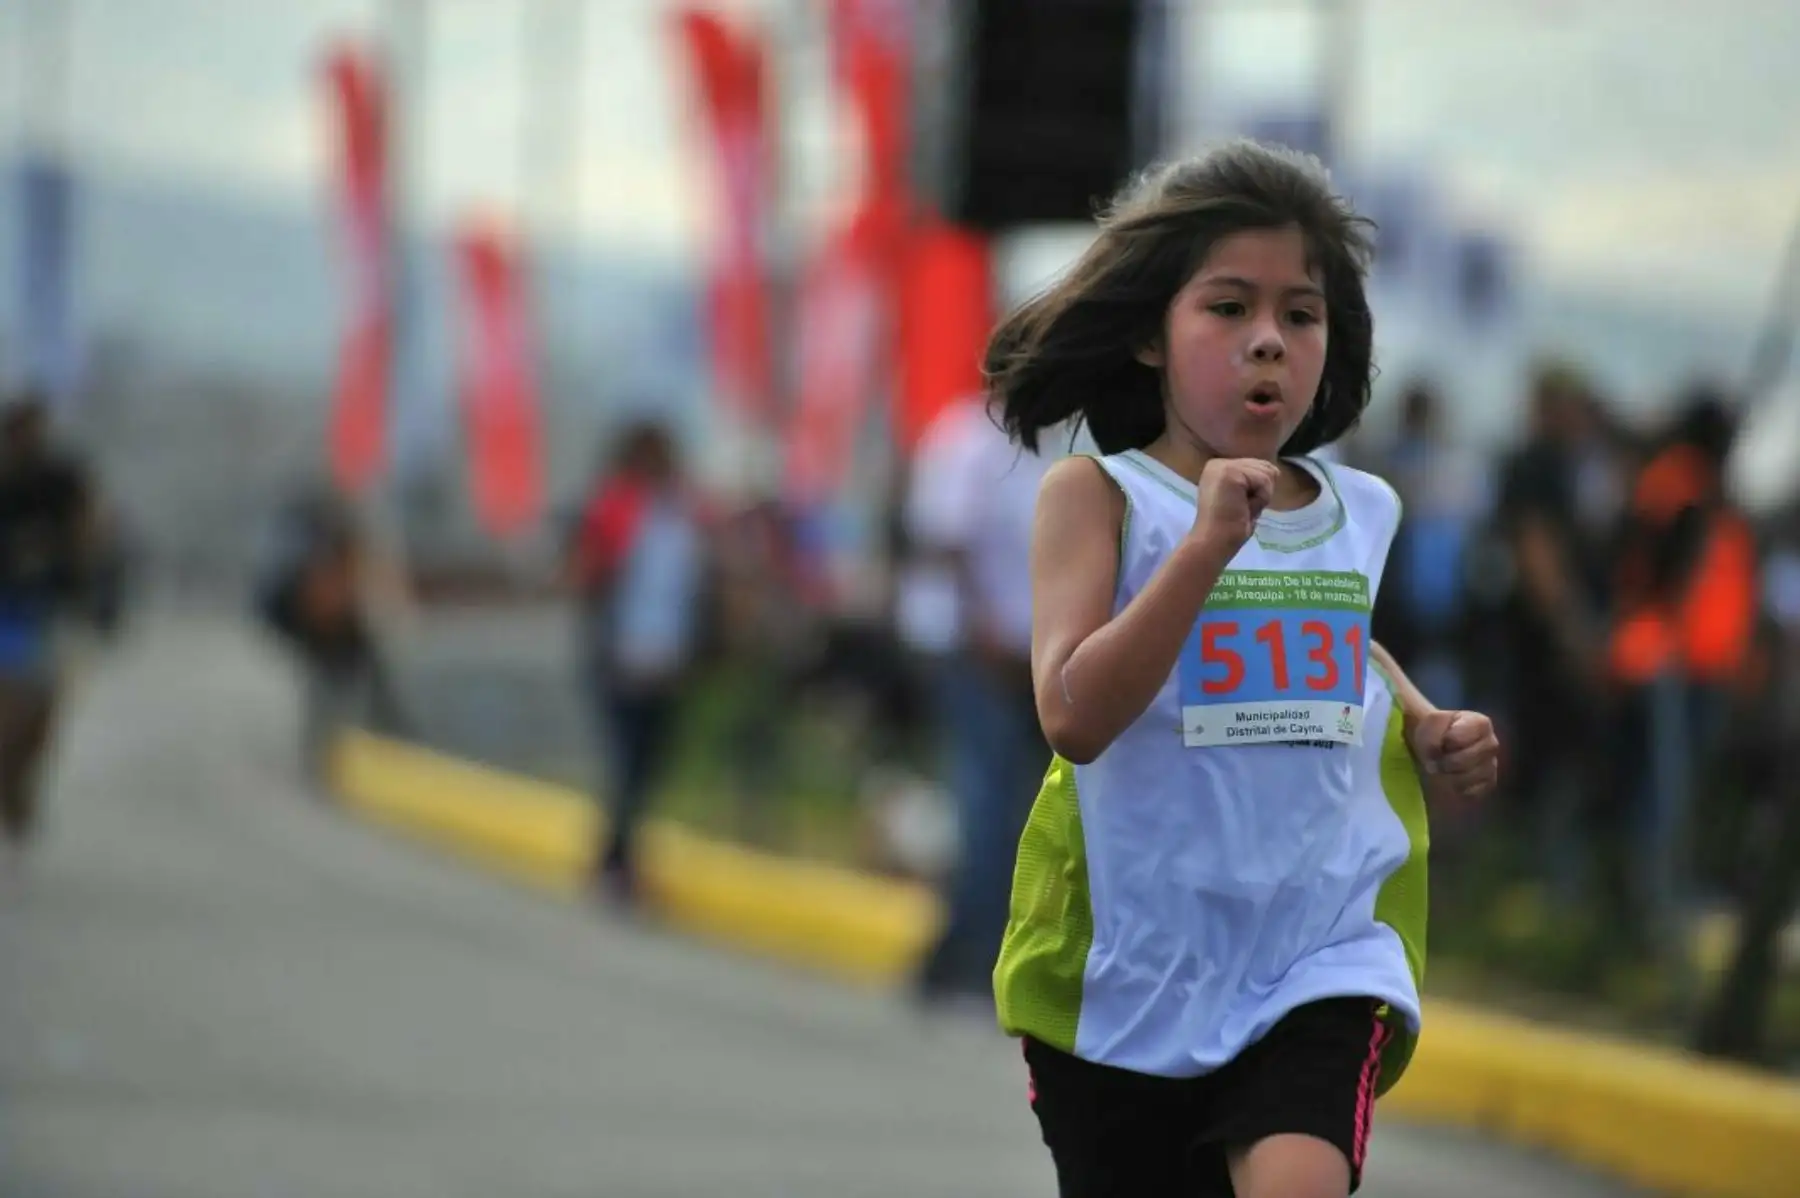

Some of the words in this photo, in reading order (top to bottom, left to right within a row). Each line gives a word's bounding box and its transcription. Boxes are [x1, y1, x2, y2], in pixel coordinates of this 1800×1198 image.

[1283, 575, 1300, 587] De
[1301, 575, 1311, 587] la
[1237, 589, 1284, 602] Arequipa
[1310, 590, 1321, 601] de
[1201, 619, 1363, 696] 5131
[1235, 709, 1311, 722] Municipalidad
[1226, 725, 1271, 738] Distrital
[1273, 724, 1288, 734] de
[1290, 723, 1324, 735] Cayma
